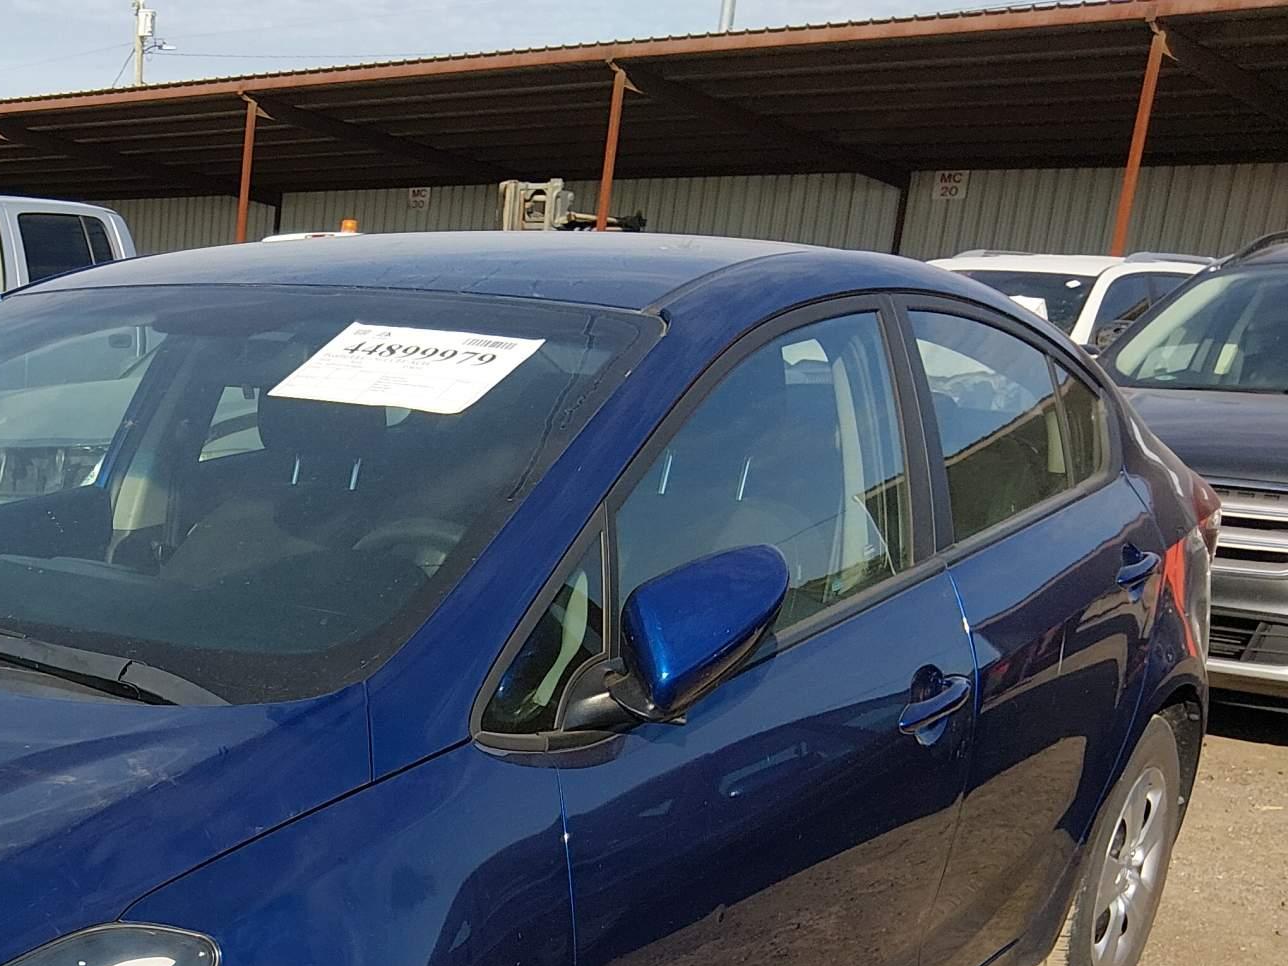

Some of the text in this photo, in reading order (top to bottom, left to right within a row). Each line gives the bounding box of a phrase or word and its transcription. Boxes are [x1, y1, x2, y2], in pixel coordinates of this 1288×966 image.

[940, 173, 963, 184] MC
[412, 189, 428, 198] MC
[940, 186, 959, 197] 20
[344, 341, 498, 366] 44899979
